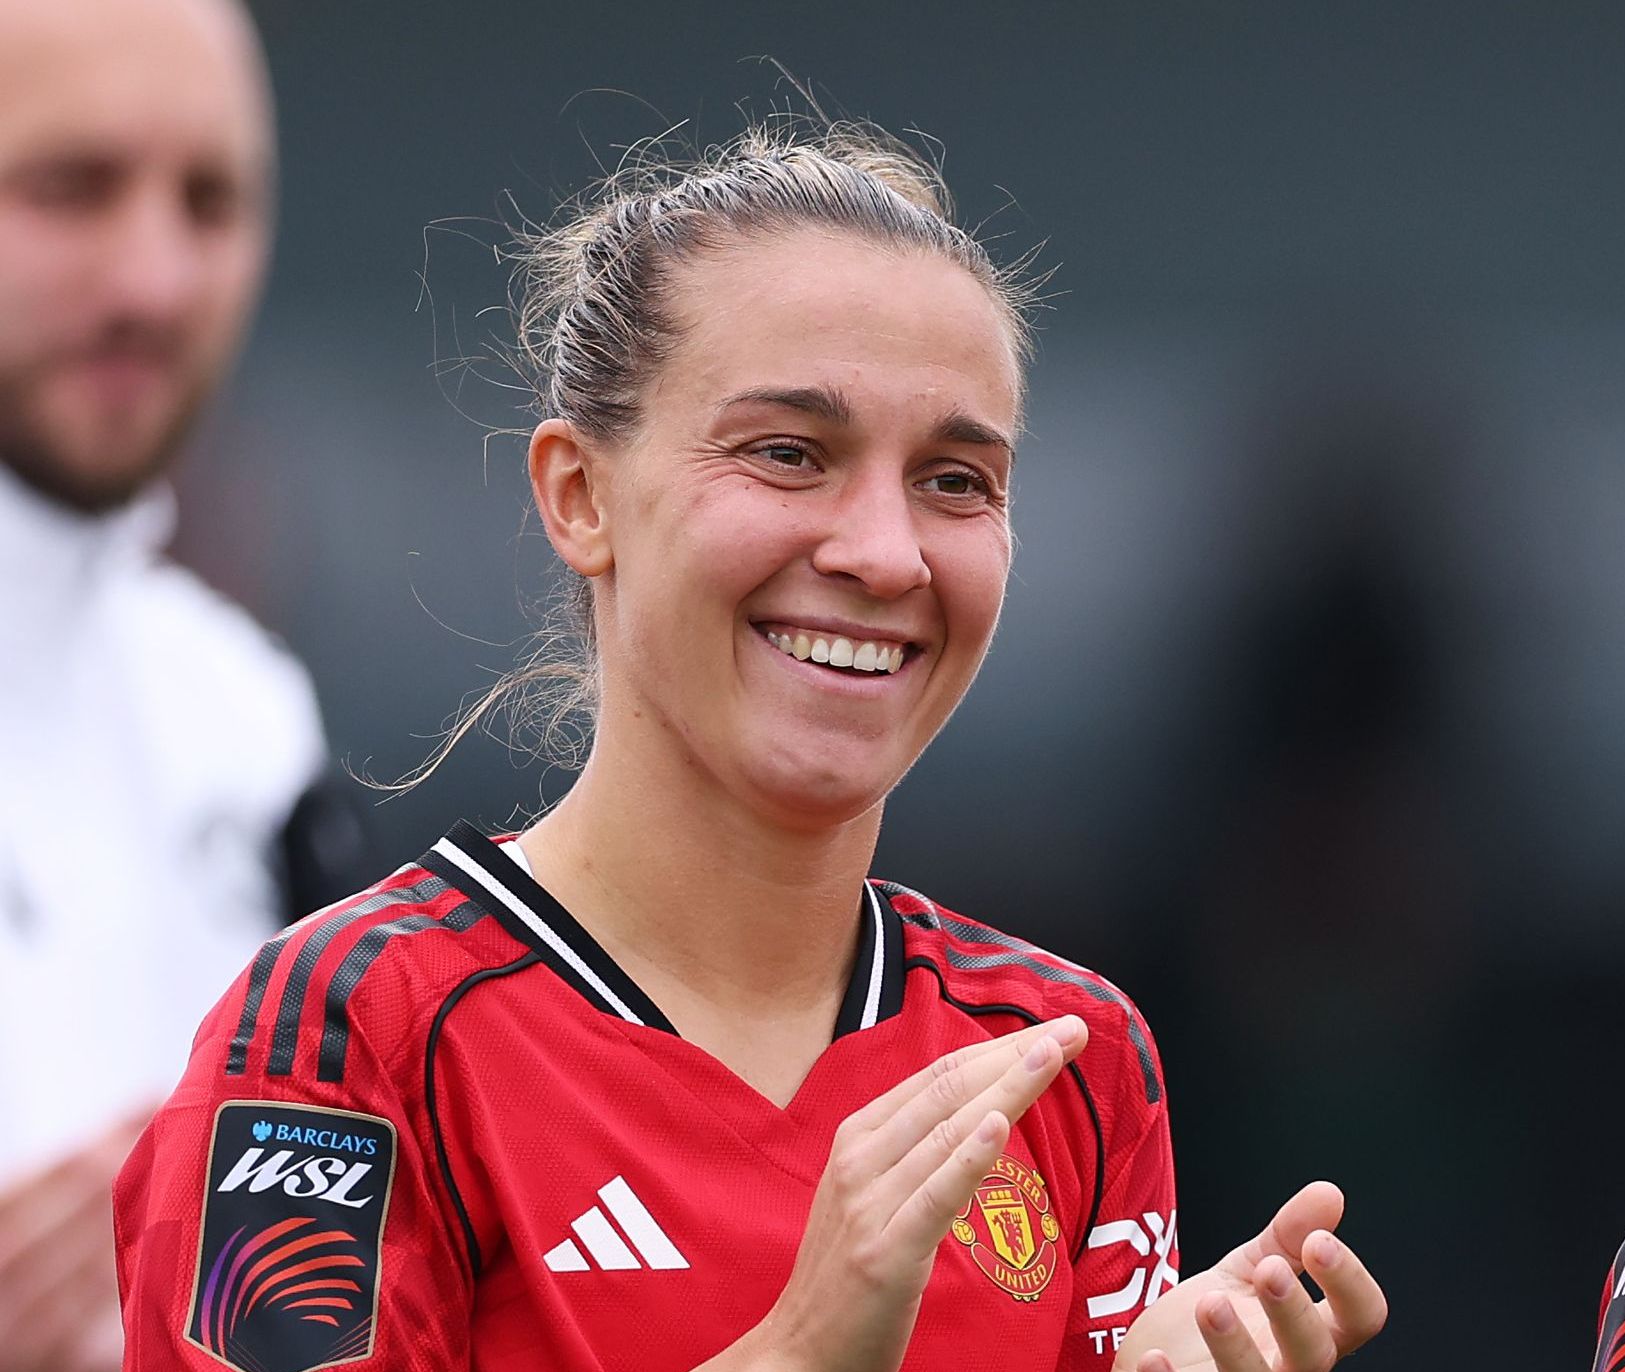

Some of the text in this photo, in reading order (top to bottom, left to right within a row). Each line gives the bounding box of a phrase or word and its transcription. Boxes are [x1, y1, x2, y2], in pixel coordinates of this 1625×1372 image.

[276, 1124, 377, 1155] BARCLAYS
[217, 1147, 374, 1208] WSL
[992, 1158, 1042, 1203] ESTER
[995, 1263, 1047, 1290] UNITED
